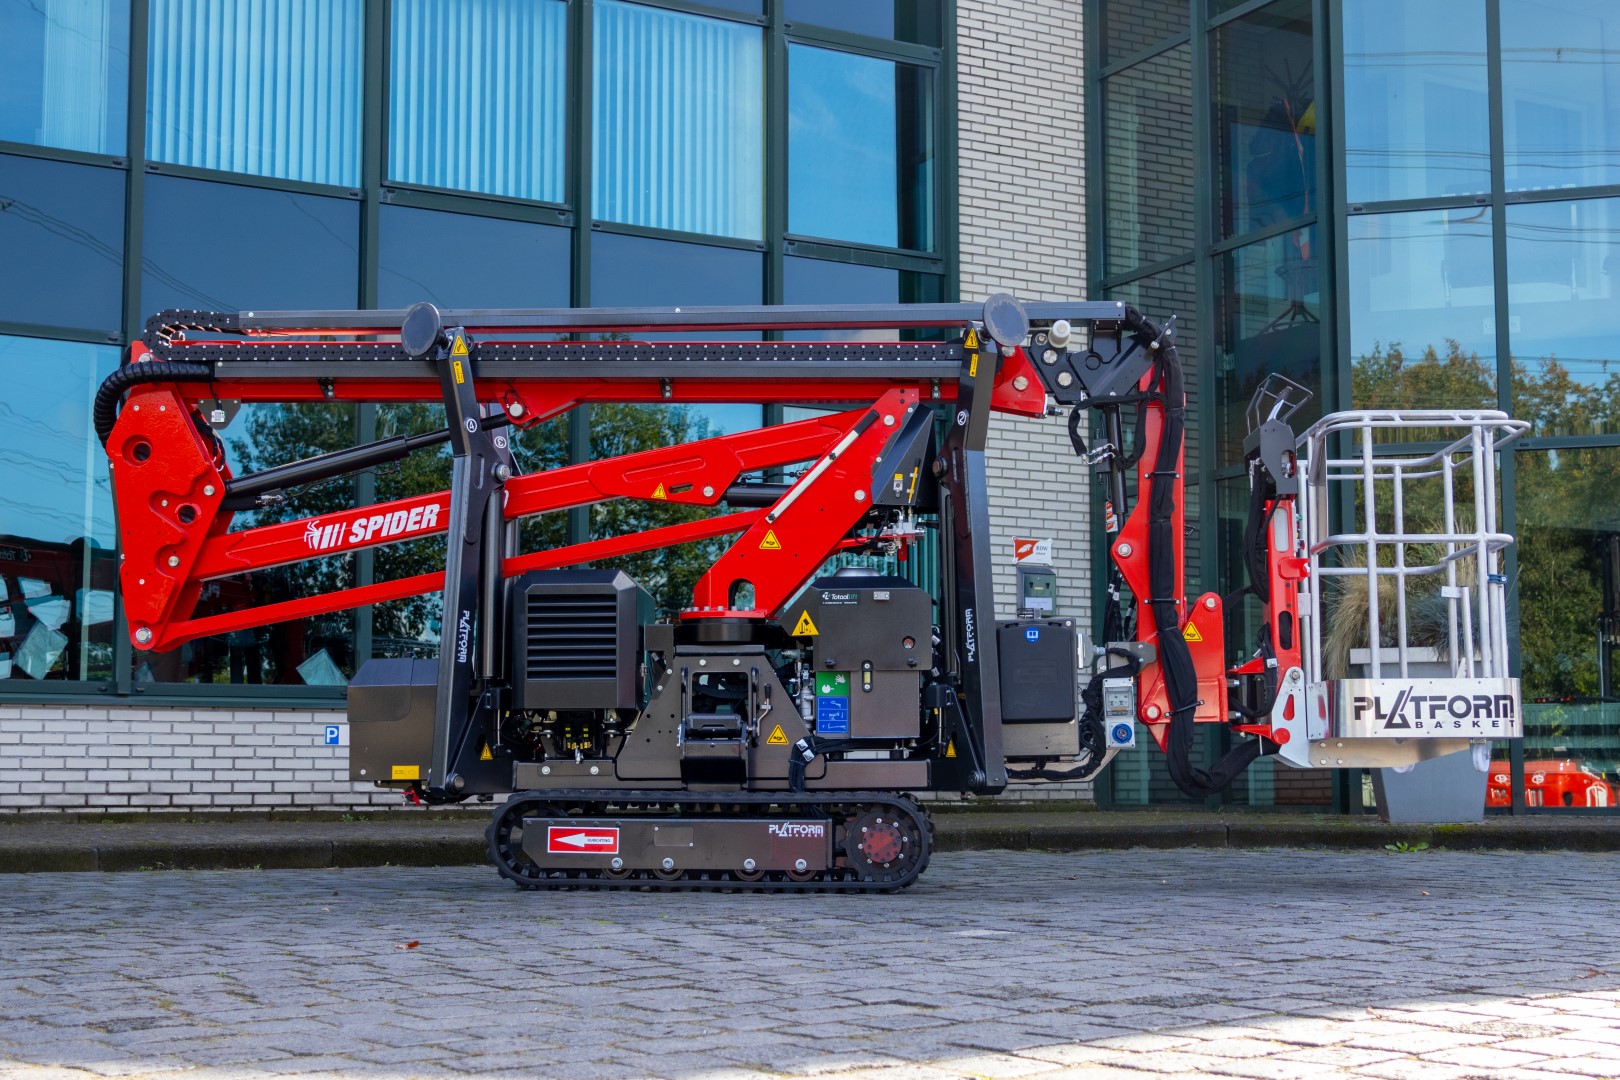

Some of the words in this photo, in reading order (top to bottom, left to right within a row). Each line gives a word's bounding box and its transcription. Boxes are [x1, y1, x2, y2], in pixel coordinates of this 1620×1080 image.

[349, 504, 440, 543] SPIDER
[459, 610, 471, 663] PLATFORM
[1353, 686, 1514, 729] PLATFORM
[326, 727, 338, 743] P
[1415, 720, 1515, 729] BASKET
[768, 821, 824, 837] PLATFORM
